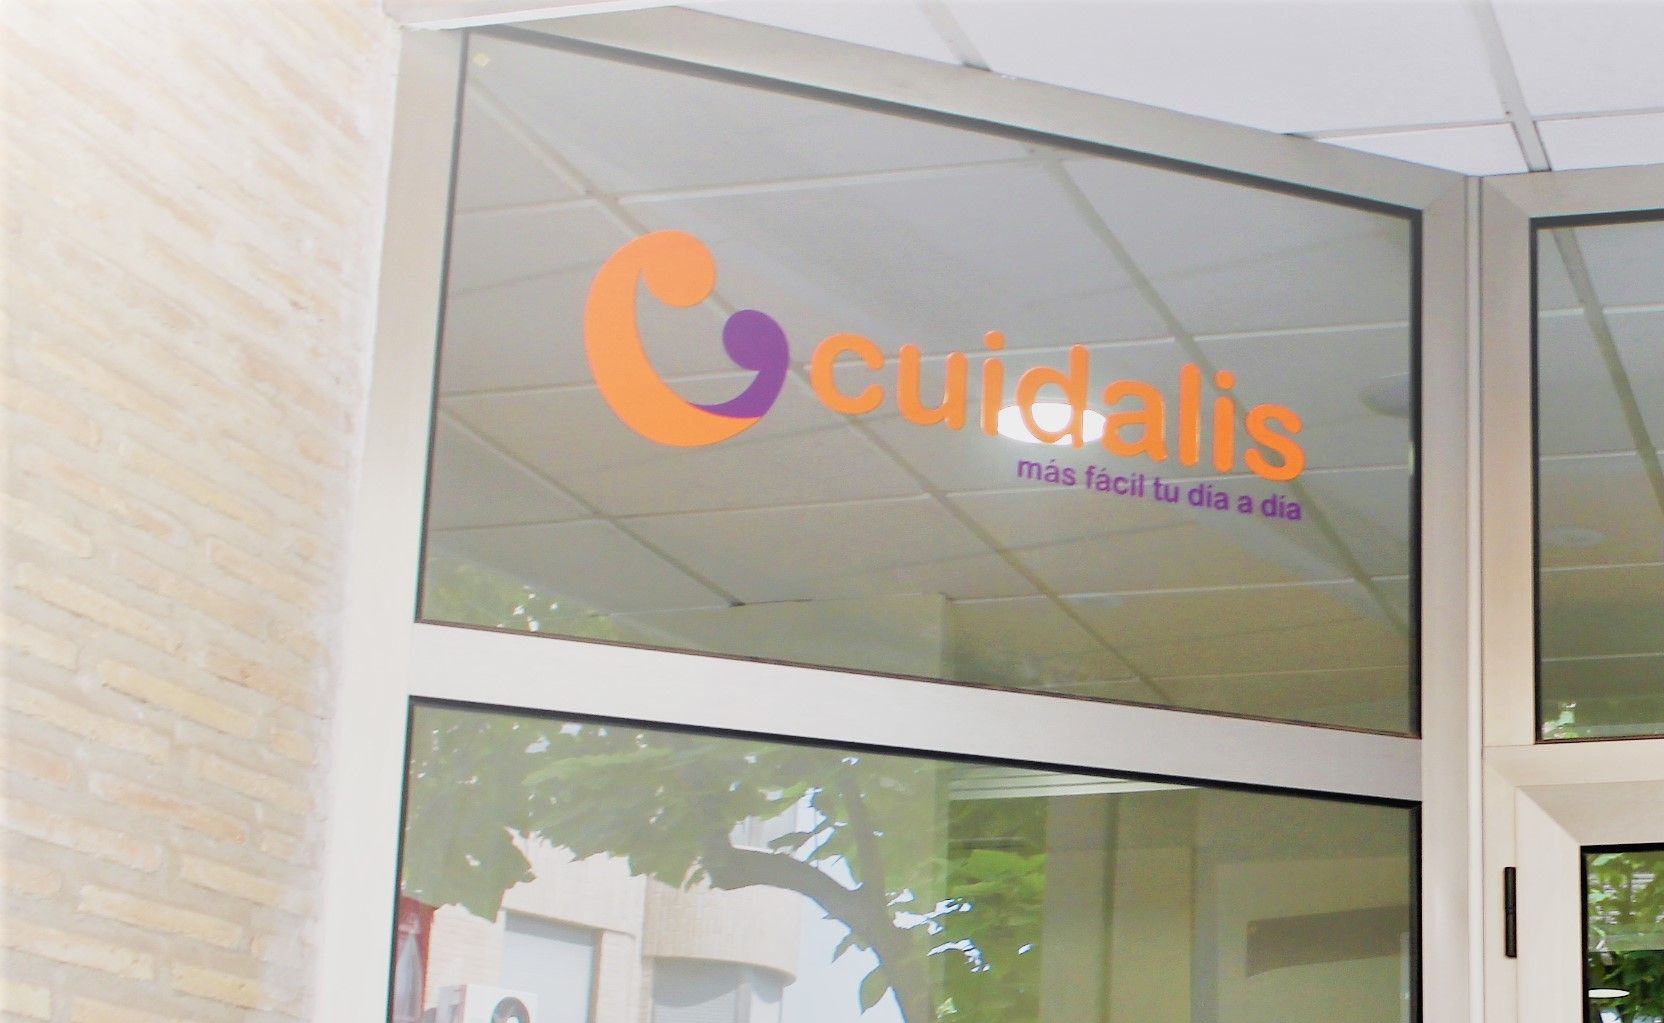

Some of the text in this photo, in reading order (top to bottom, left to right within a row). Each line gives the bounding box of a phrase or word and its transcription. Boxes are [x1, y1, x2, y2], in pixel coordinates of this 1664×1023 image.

[808, 330, 1306, 482] cuidalis
[1017, 459, 1303, 521] más fácil tu día a día
